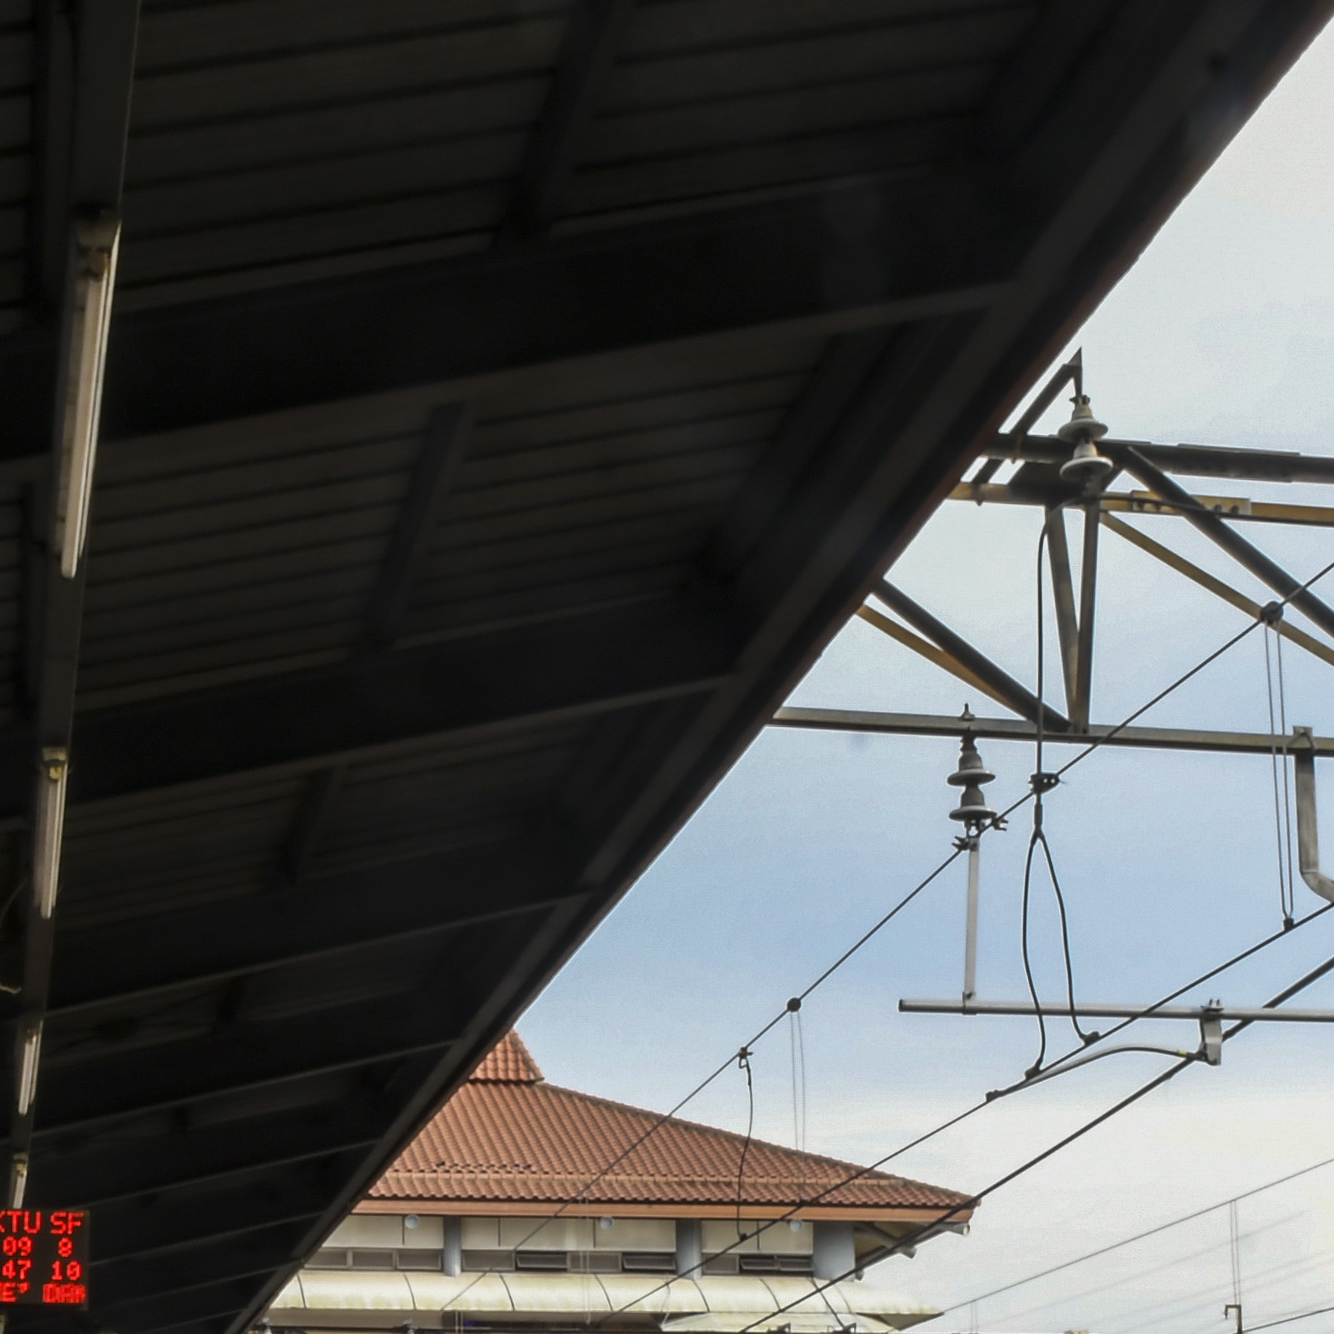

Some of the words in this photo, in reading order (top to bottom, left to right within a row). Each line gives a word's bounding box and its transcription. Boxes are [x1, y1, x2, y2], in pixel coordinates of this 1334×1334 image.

[50, 1211, 85, 1235] SF
[58, 1237, 73, 1257] 8
[51, 1261, 82, 1281] 10
